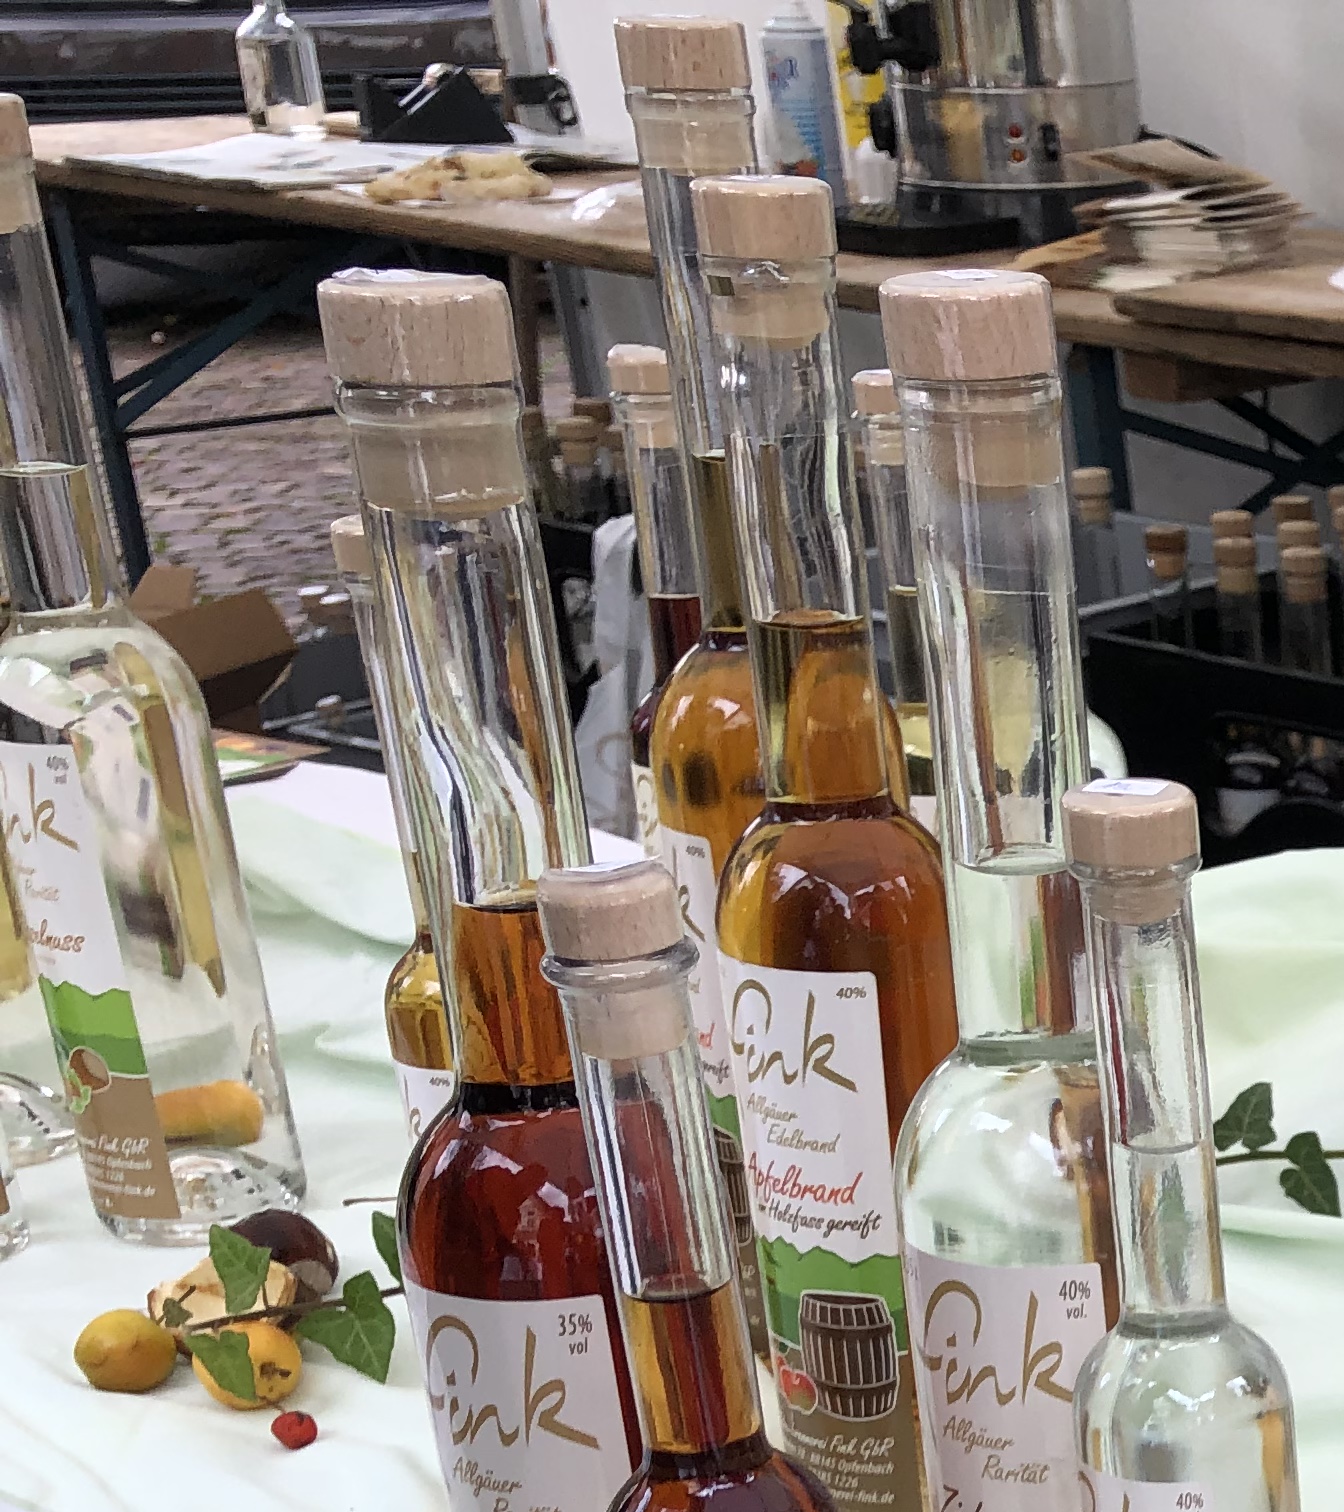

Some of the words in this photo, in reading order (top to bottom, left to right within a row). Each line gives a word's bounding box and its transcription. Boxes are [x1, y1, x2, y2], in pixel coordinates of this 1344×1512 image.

[2, 763, 80, 852] nk
[28, 918, 85, 953] elnuss
[836, 986, 867, 1000] 40%
[746, 1093, 798, 1127] Allgäuer
[767, 1125, 840, 1154] Edelbrand
[747, 1150, 863, 1206] Apfelbrand
[768, 1201, 825, 1233] Holzfass
[825, 1210, 882, 1233] gereift
[1058, 1280, 1091, 1301] 40%
[557, 1313, 594, 1337] 35%
[1066, 1306, 1088, 1319] vol.
[568, 1339, 589, 1355] vol
[919, 1279, 1073, 1406] fink
[427, 1315, 601, 1452] fink
[860, 1436, 895, 1460] GbR
[942, 1416, 1014, 1454] Allgäuer
[452, 1456, 523, 1495] Allgäuer
[981, 1455, 1051, 1483] Rarität
[1176, 1493, 1204, 1510] 40%
